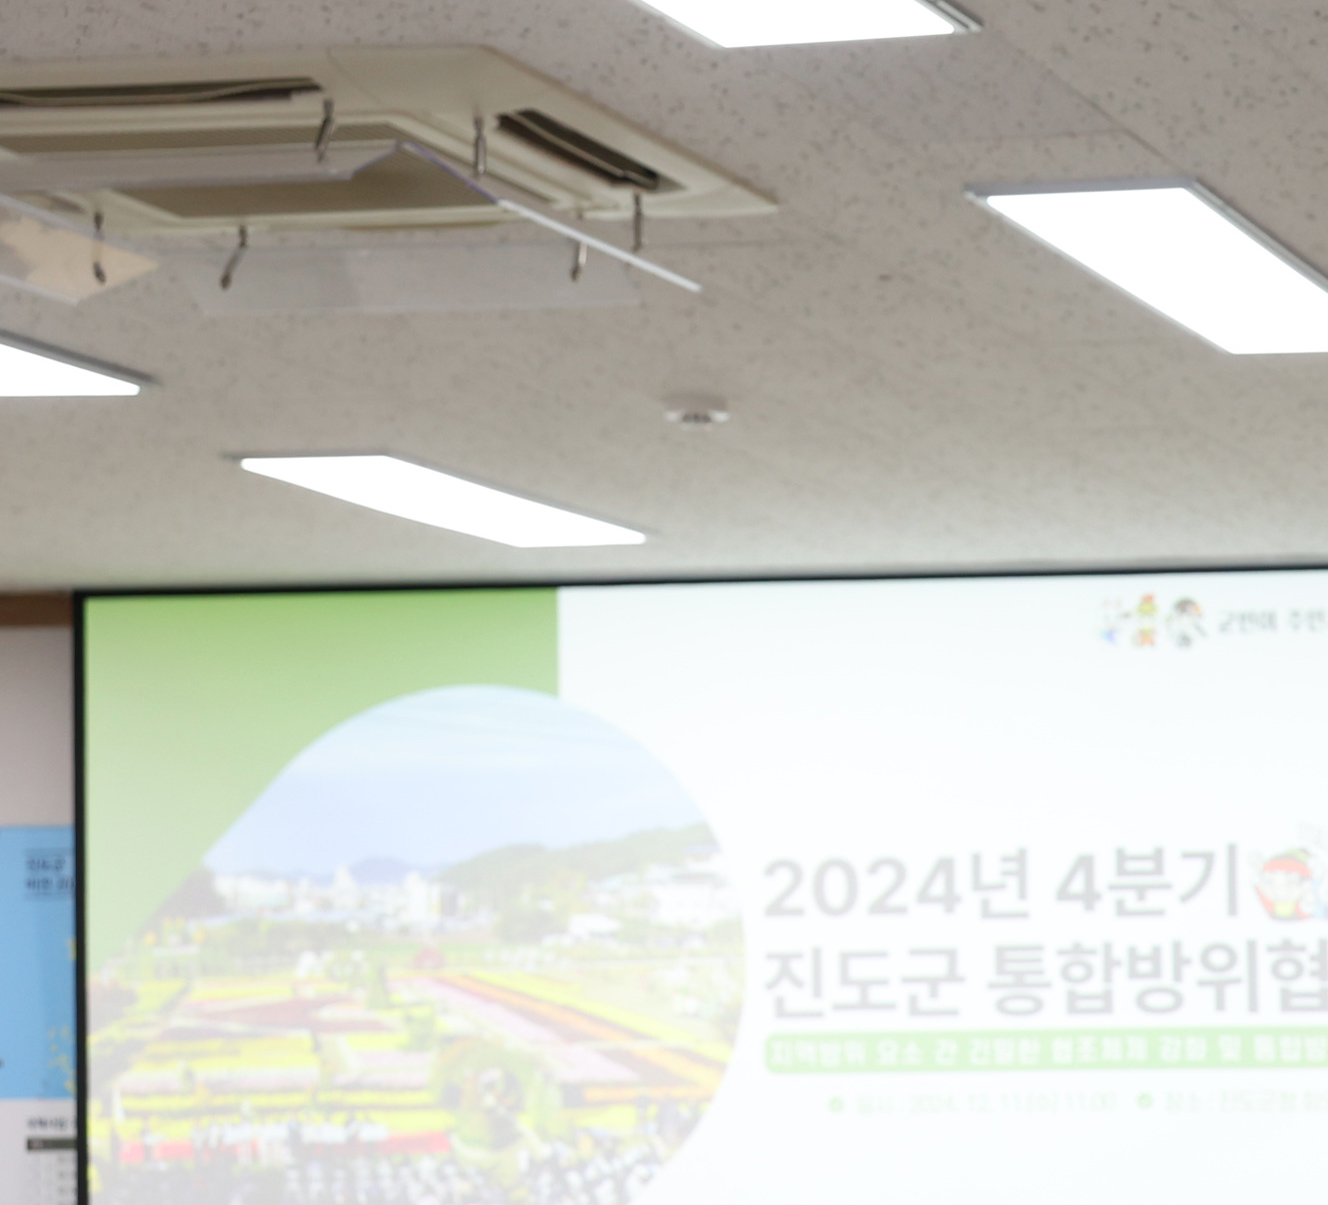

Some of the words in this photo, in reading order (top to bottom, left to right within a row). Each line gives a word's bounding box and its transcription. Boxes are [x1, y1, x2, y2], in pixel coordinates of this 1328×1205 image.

[763, 847, 1030, 919] 2024년
[1055, 843, 1239, 917] 4분기
[764, 947, 967, 1018] 진도군
